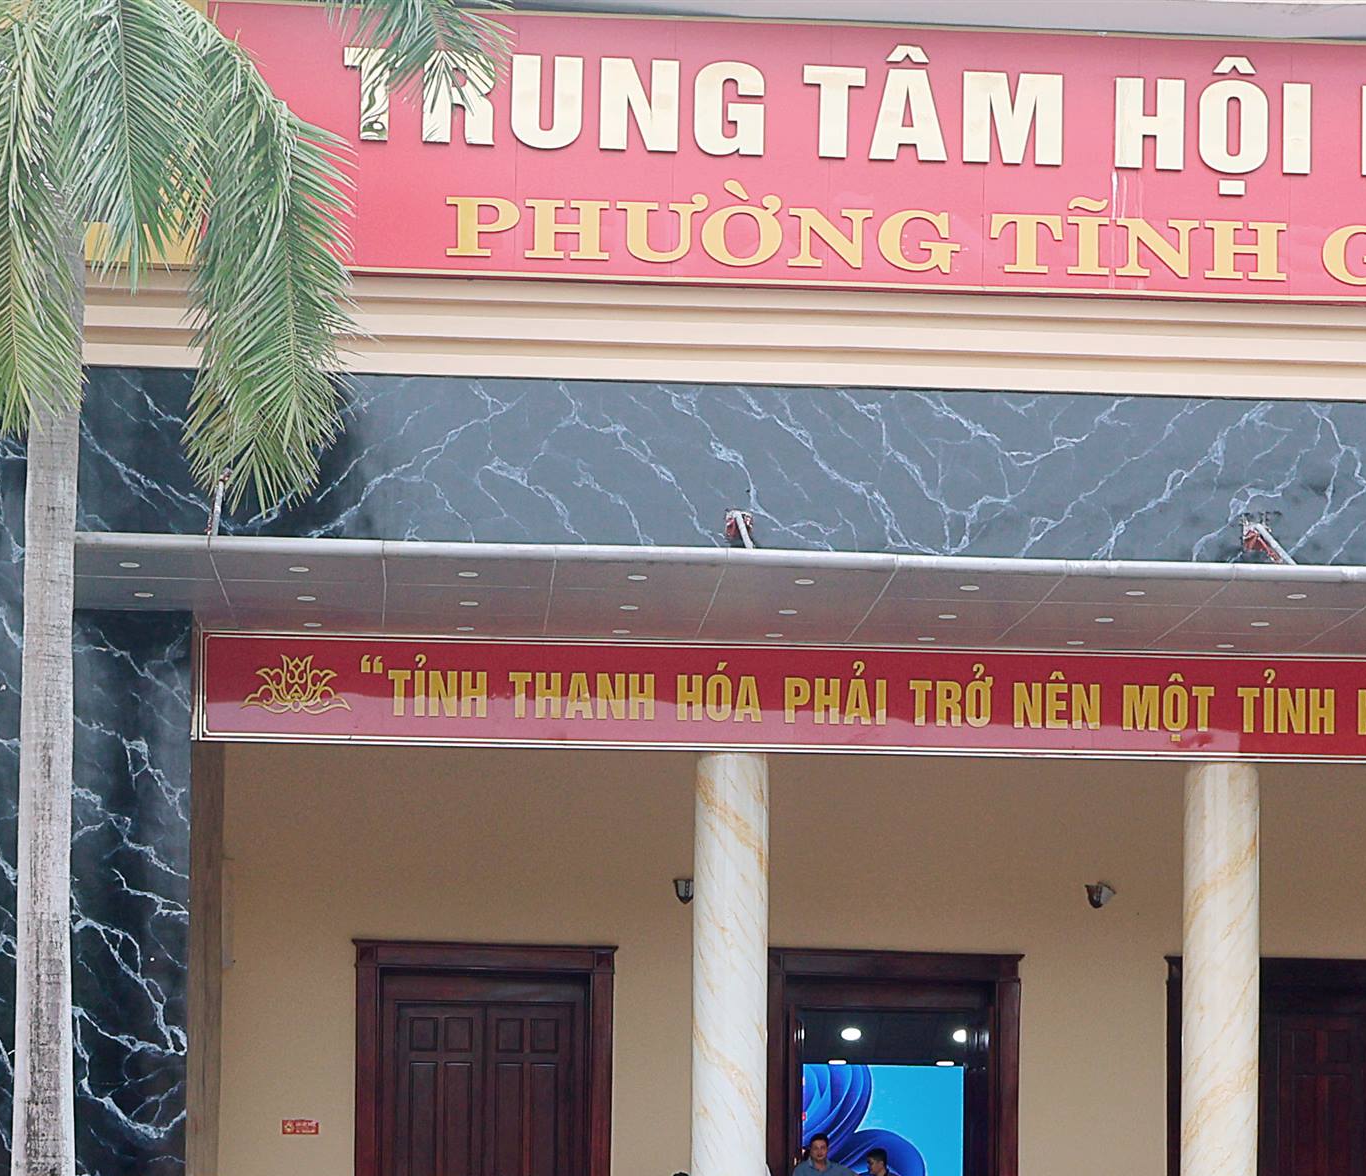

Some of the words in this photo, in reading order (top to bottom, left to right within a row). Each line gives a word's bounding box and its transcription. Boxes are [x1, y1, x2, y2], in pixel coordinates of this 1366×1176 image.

[343, 46, 765, 157] TRUNG
[803, 45, 1064, 167] TÂM
[1115, 56, 1312, 196] HỘI
[445, 180, 961, 274] PHƯỜNG
[989, 197, 1288, 282] TĨNH
[509, 671, 656, 722] THANH
[676, 660, 762, 724] HÓA
[784, 659, 888, 727] PHẢI
[909, 663, 994, 729] TRỞ
[1013, 671, 1102, 731] NÊN
[1122, 672, 1215, 742] MỘT
[1237, 668, 1336, 736] TỈNH
